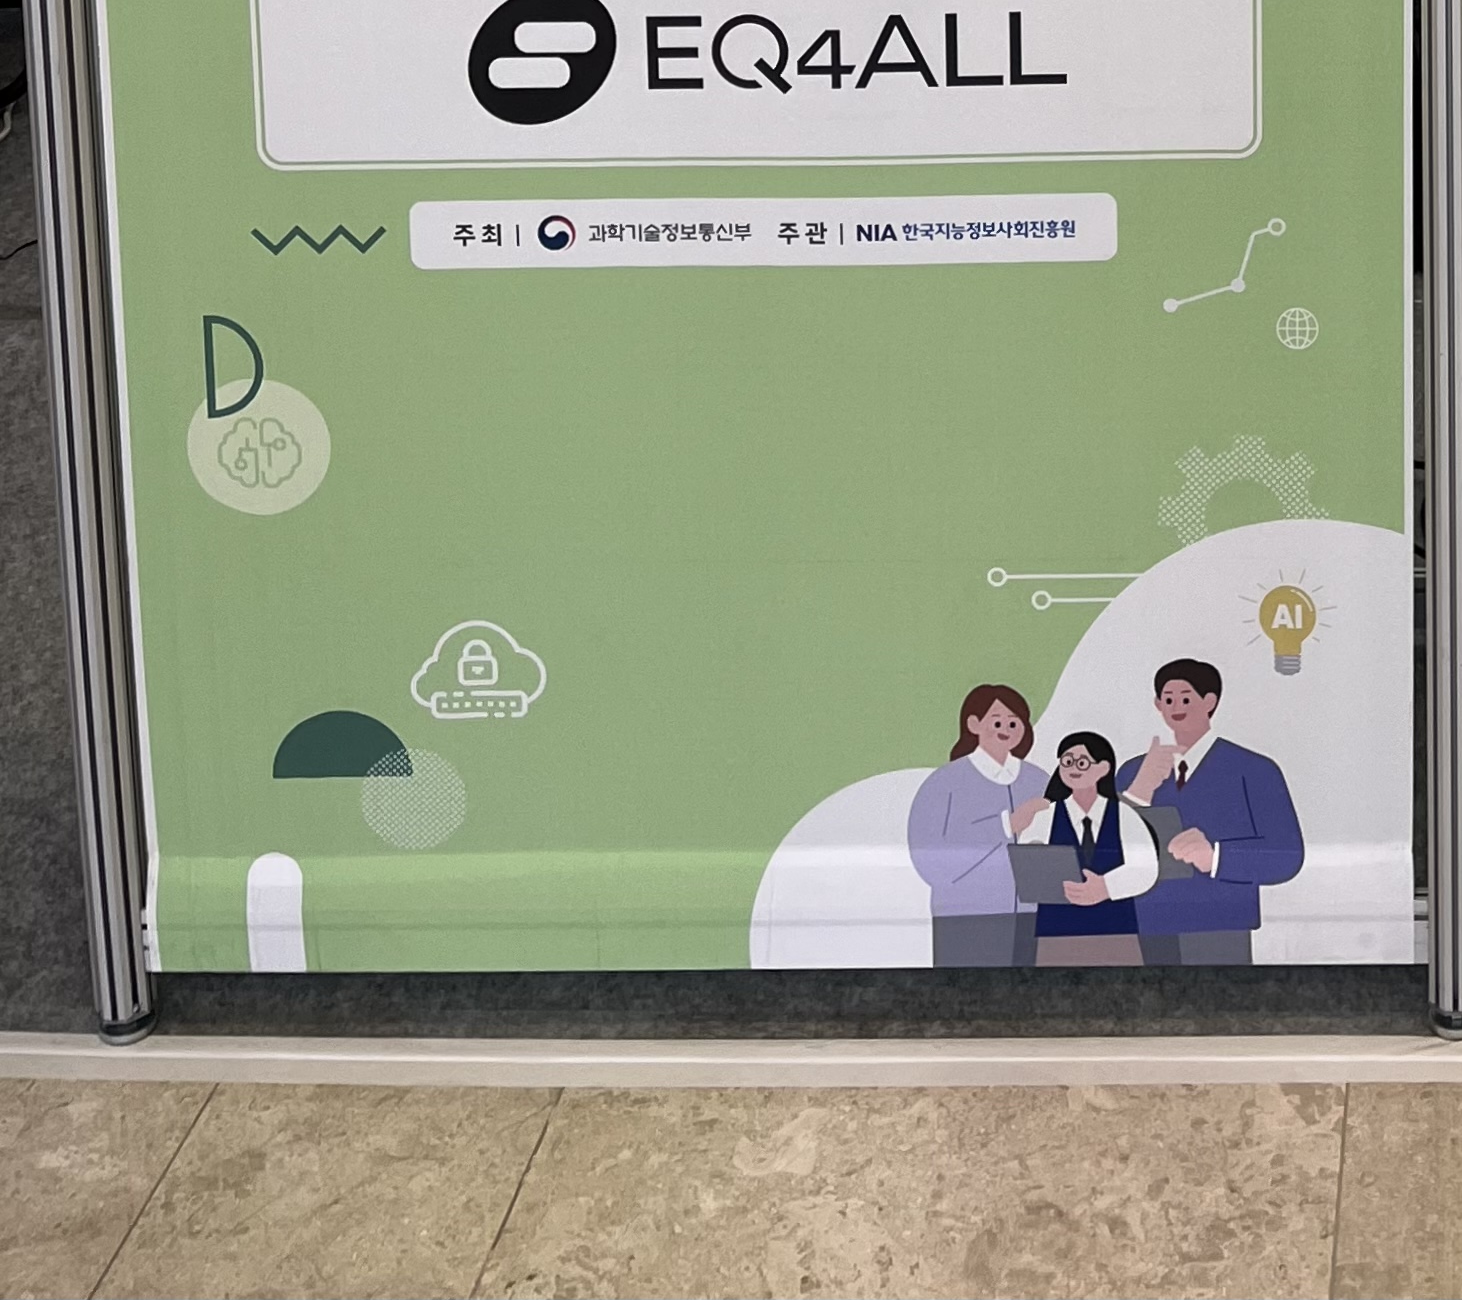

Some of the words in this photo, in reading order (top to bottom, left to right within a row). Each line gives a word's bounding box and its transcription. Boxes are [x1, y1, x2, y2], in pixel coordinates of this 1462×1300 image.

[646, 11, 1067, 94] EQ4ALL
[589, 223, 751, 242] 과학기술정보통신부
[857, 224, 897, 242] NIA
[902, 220, 1075, 241] 한국지능정보사회진흥원
[1271, 603, 1303, 629] AI
